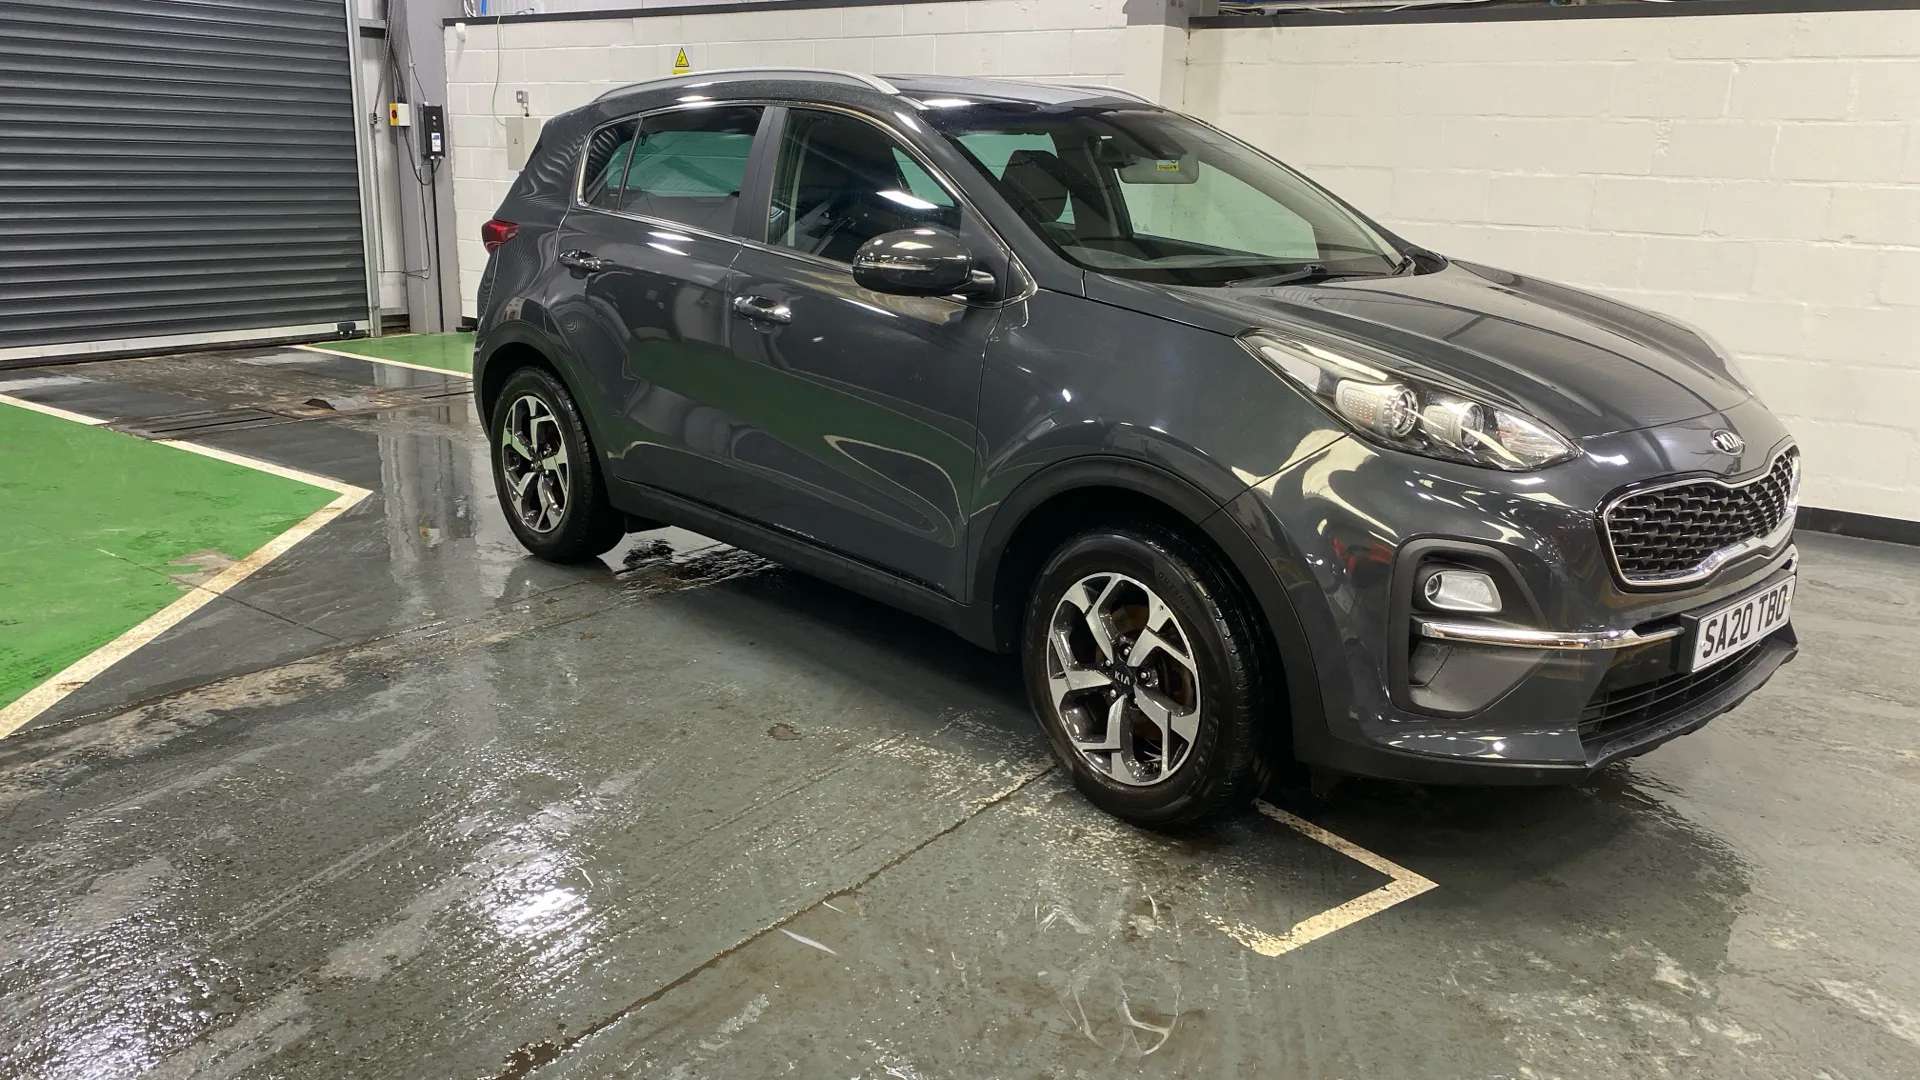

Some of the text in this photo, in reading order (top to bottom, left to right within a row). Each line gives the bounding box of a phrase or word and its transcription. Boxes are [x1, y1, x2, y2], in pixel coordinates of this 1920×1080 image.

[1703, 585, 1788, 658] SA20 TBO
[1114, 671, 1130, 685] KIA
